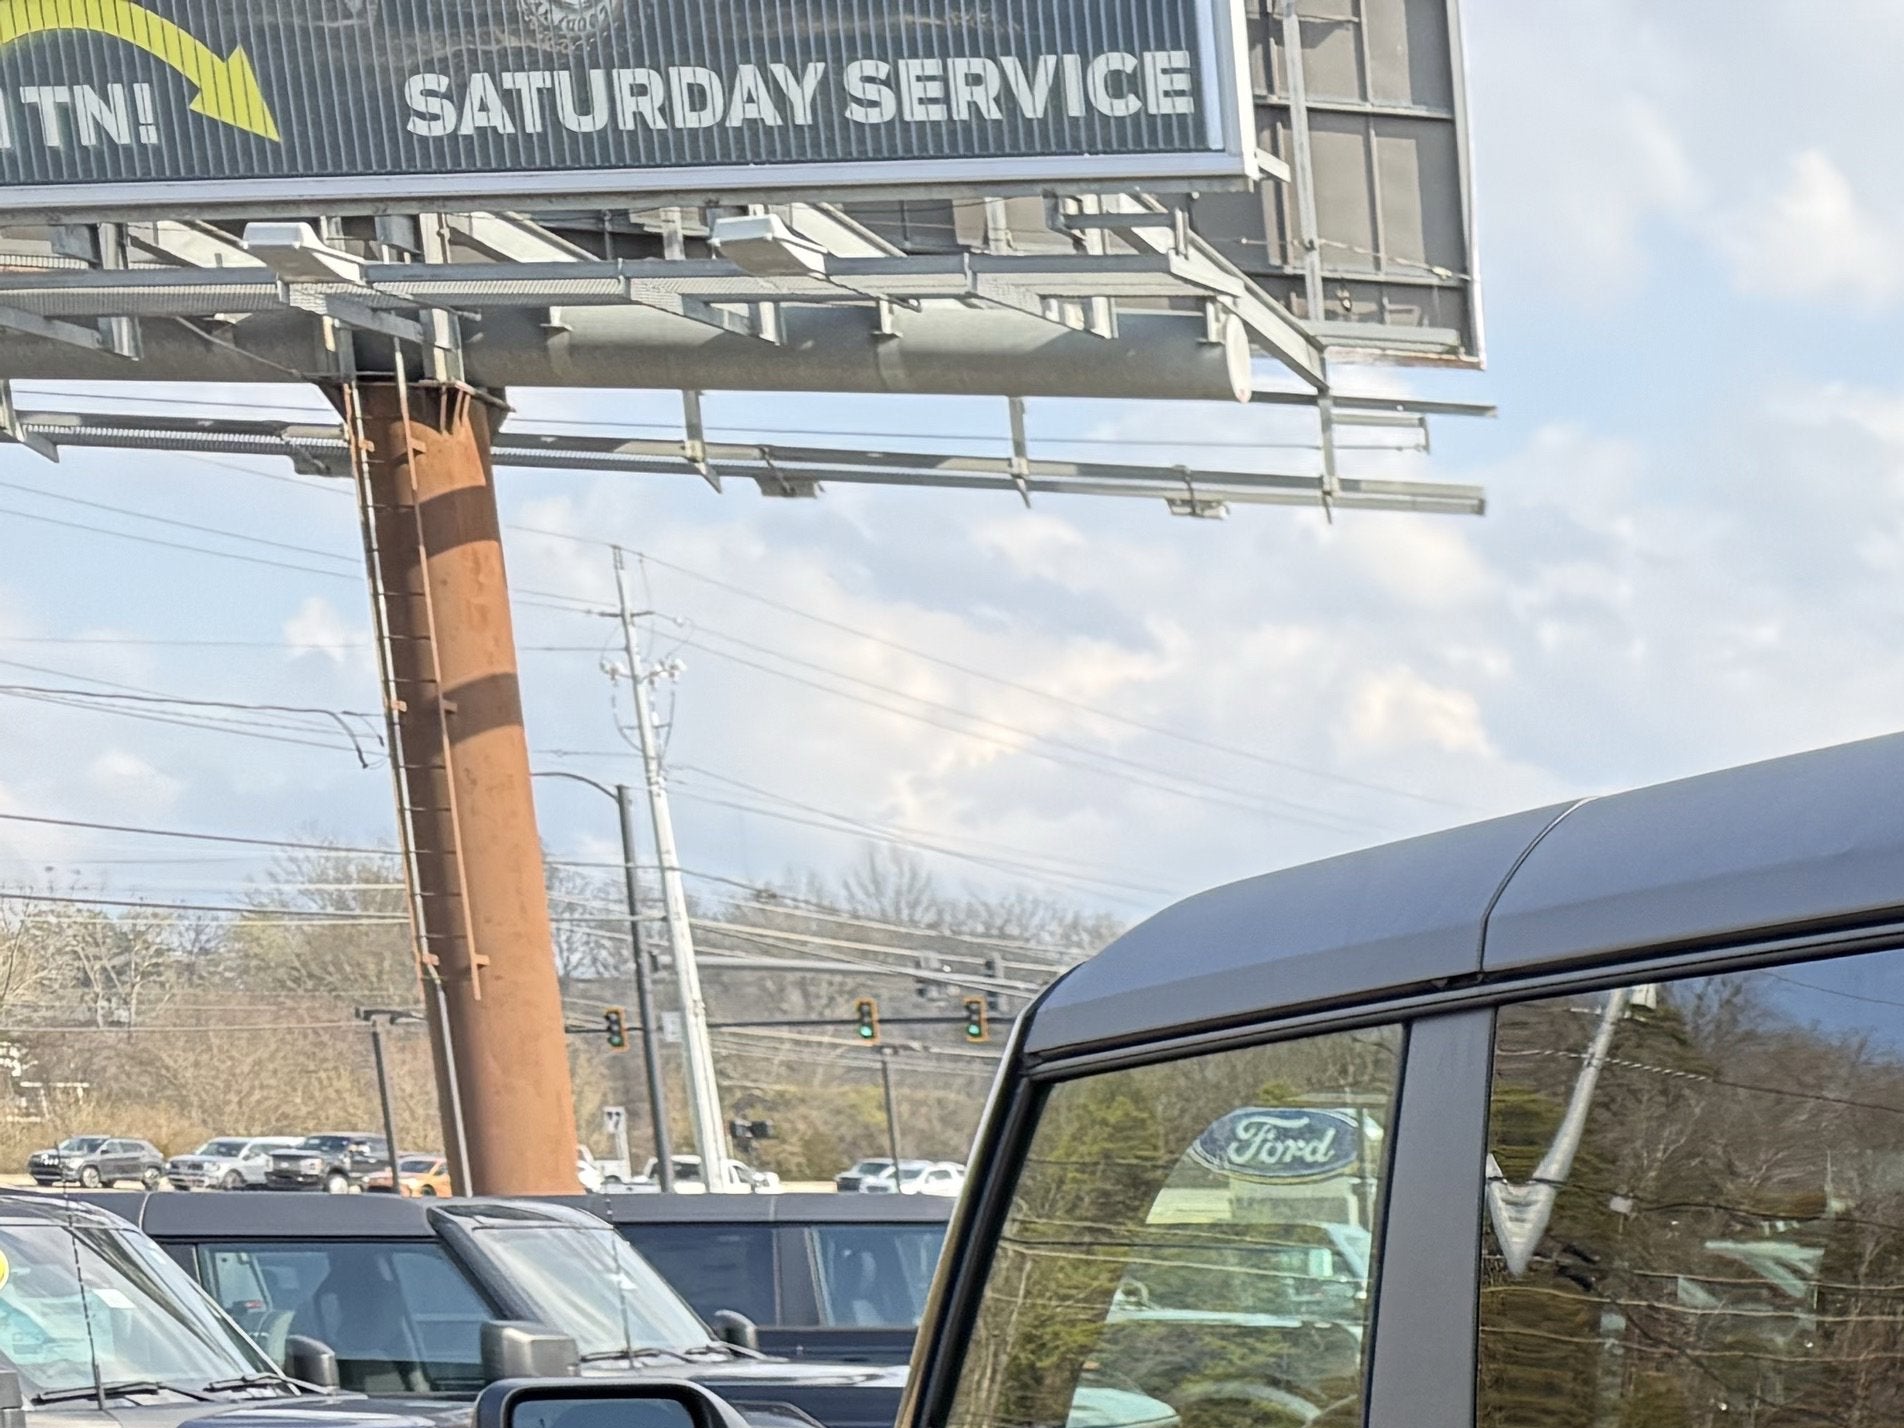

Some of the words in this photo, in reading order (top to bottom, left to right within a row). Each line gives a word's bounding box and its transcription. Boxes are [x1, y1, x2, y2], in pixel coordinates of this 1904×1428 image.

[19, 82, 158, 146] TN!
[404, 61, 826, 137] SATURDAY
[843, 50, 1195, 125] SERVICE
[1226, 1115, 1337, 1165] Ford
